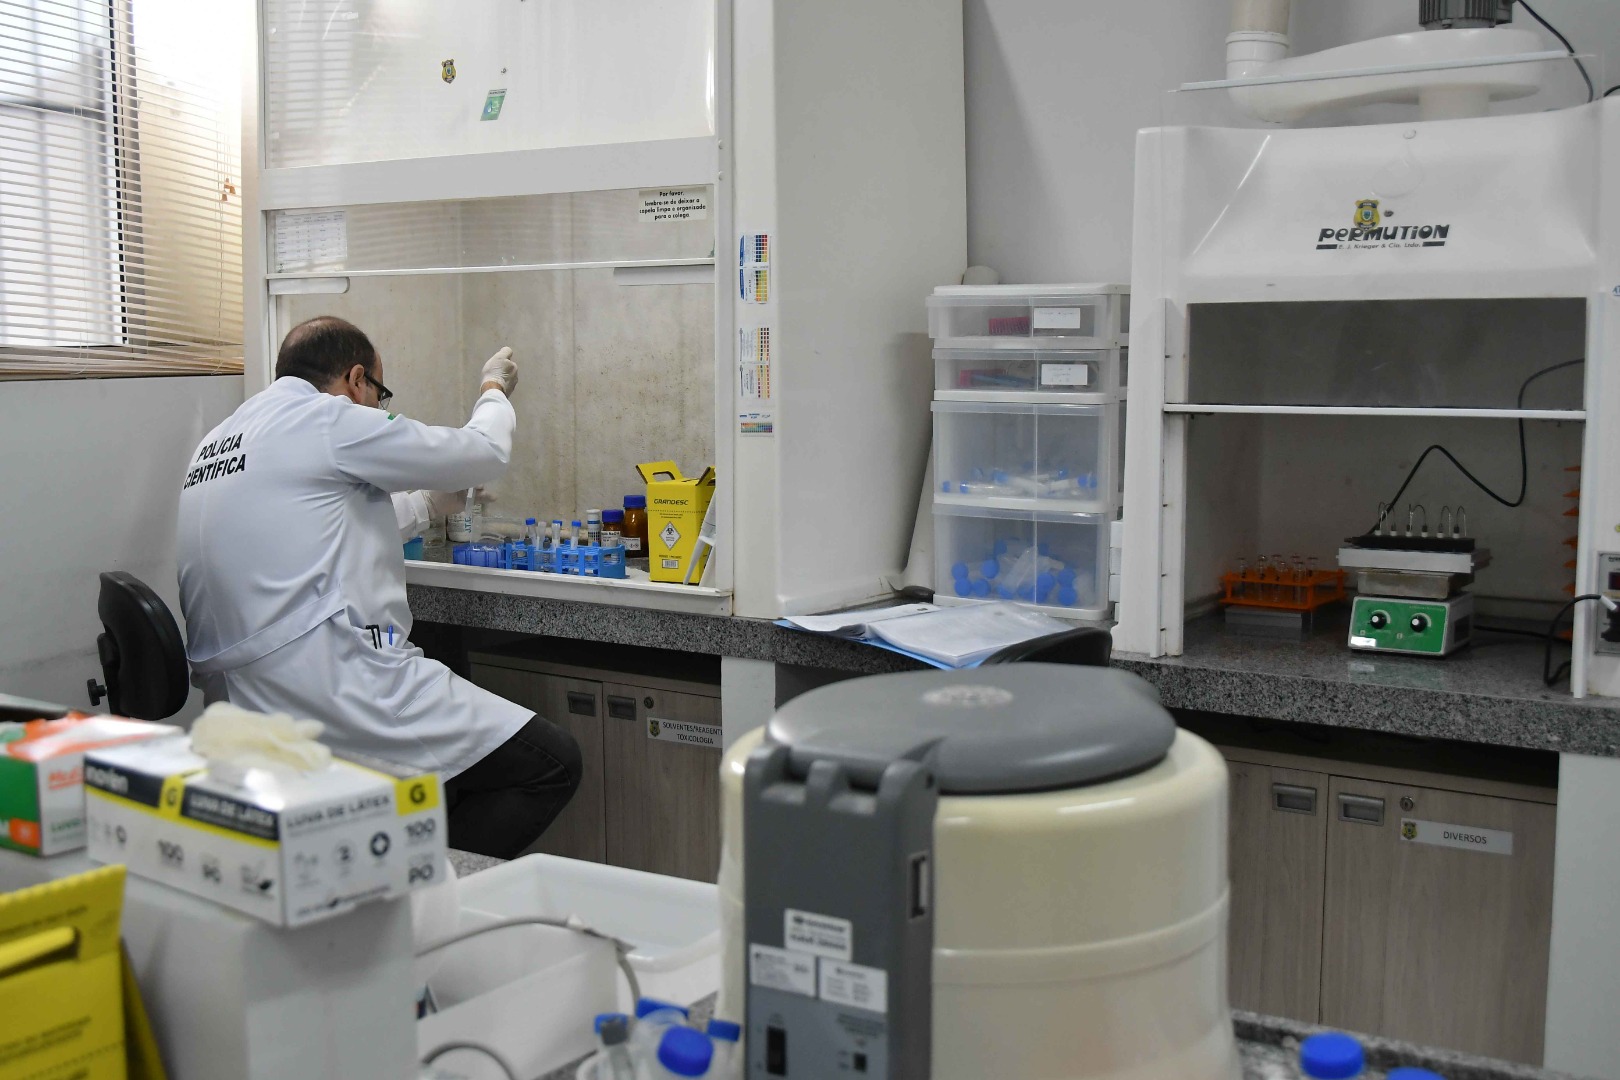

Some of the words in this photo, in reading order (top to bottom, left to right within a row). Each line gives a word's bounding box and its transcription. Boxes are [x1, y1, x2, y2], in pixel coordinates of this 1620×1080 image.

[653, 498, 689, 506] GRANDESC
[676, 733, 714, 744] TOXICOLOGIA
[409, 784, 426, 805] G
[405, 817, 436, 838] 100
[1443, 830, 1487, 845] DIVERSOS
